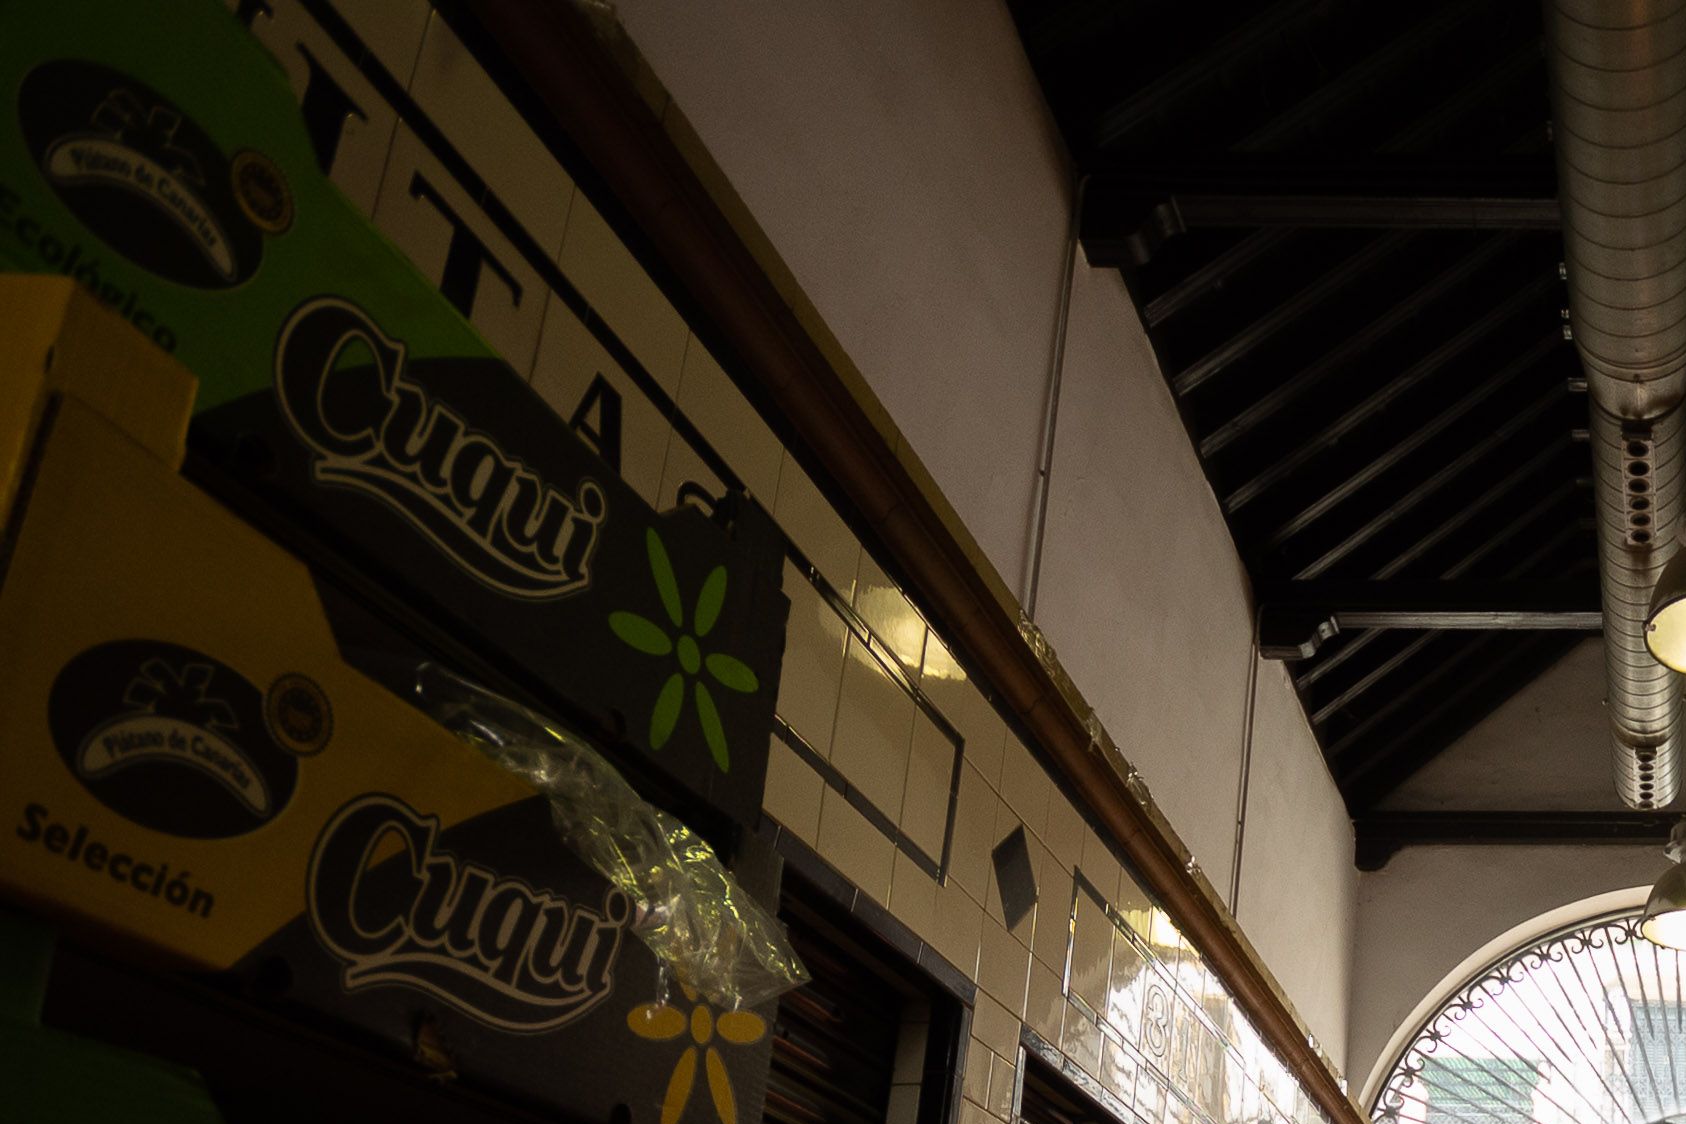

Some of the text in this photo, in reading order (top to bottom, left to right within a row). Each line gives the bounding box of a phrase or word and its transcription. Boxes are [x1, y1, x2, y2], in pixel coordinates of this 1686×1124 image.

[274, 294, 608, 592] Cuqui
[15, 802, 216, 918] Selección
[305, 792, 637, 1012] Cuqui
